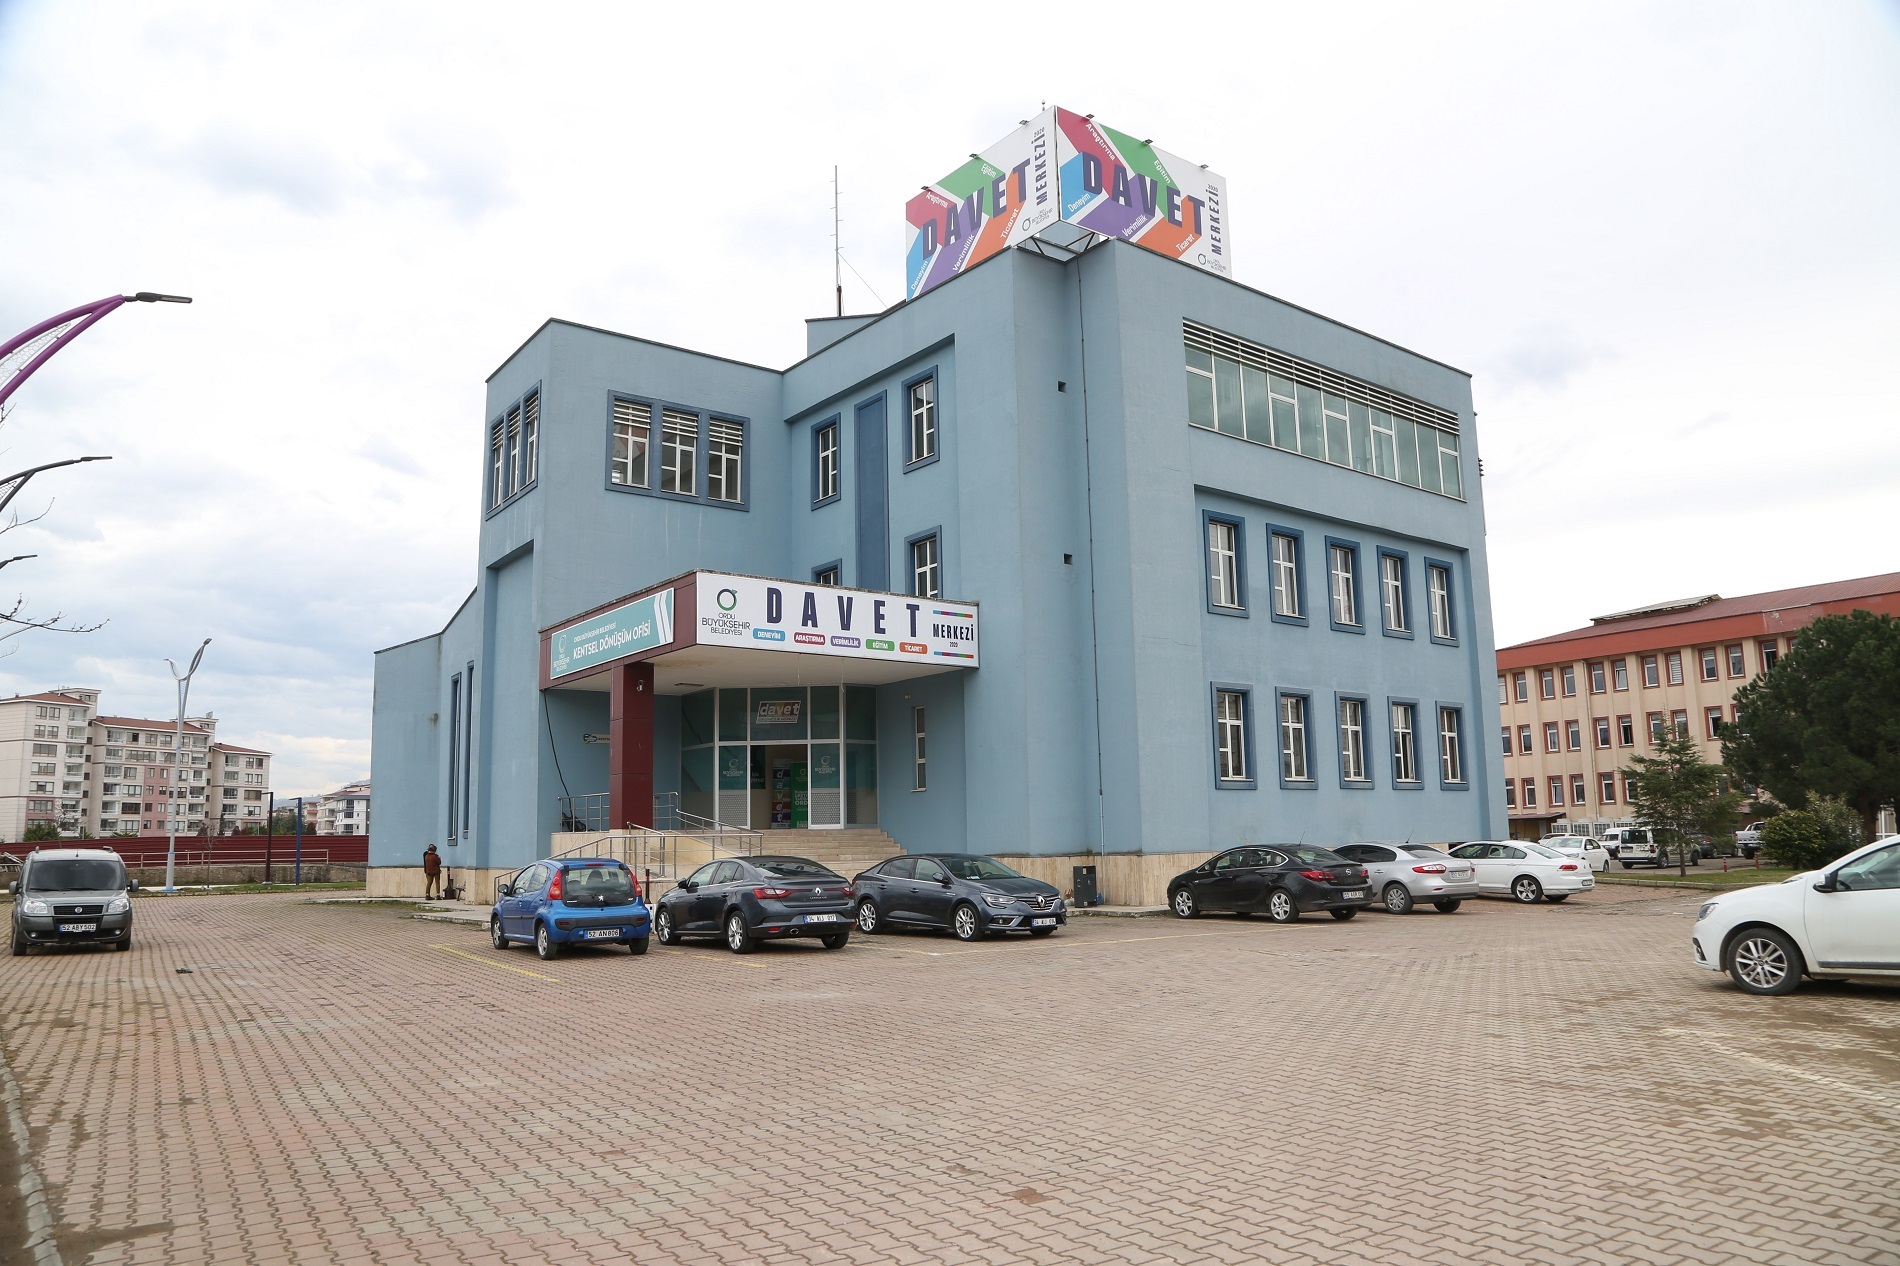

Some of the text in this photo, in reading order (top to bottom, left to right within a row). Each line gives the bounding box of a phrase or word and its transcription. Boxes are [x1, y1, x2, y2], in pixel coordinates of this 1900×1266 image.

[1031, 133, 1048, 206] MERKEZİ
[923, 157, 1030, 261] DAVET
[1082, 151, 1206, 236] DAVET
[1000, 207, 1020, 239] Ticaret
[1205, 188, 1222, 256] MERKEZİ
[1175, 234, 1195, 253] Ticaret
[718, 612, 736, 620] ORDU
[766, 587, 920, 638] DAVET
[573, 619, 651, 660] KENTSEL DÖNÜŞÜM OFİSİ
[795, 634, 825, 644] ARAŞTIRMA
[832, 637, 859, 647] VERİMLİLİK
[933, 623, 974, 641] MERKEZİ
[760, 703, 799, 715] davet
